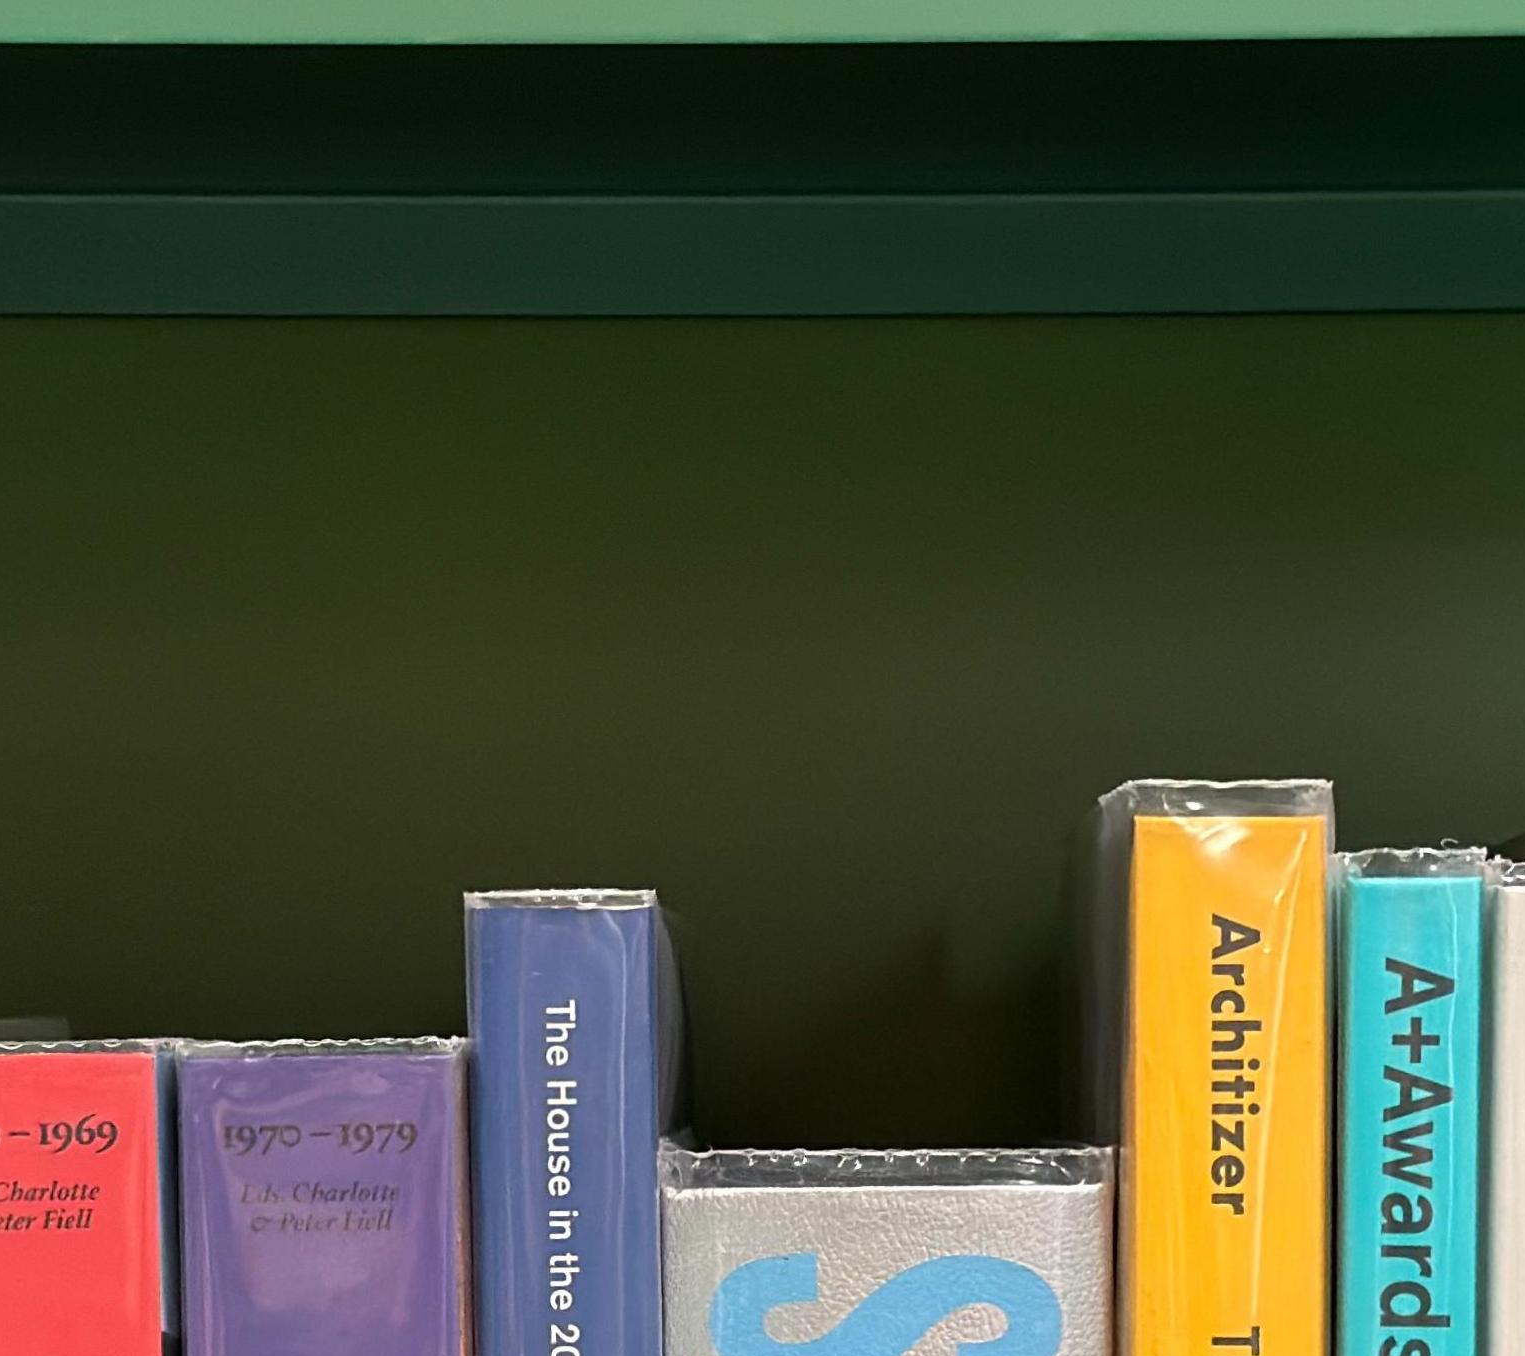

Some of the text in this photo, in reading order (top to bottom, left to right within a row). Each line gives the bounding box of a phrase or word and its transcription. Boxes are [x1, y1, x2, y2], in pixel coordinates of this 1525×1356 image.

[544, 998, 577, 1066] The
[1209, 912, 1263, 1217] Architizer
[545, 1080, 579, 1198] House
[42, 1207, 93, 1231] Fiell
[546, 1210, 580, 1240] in
[548, 1252, 581, 1311] the
